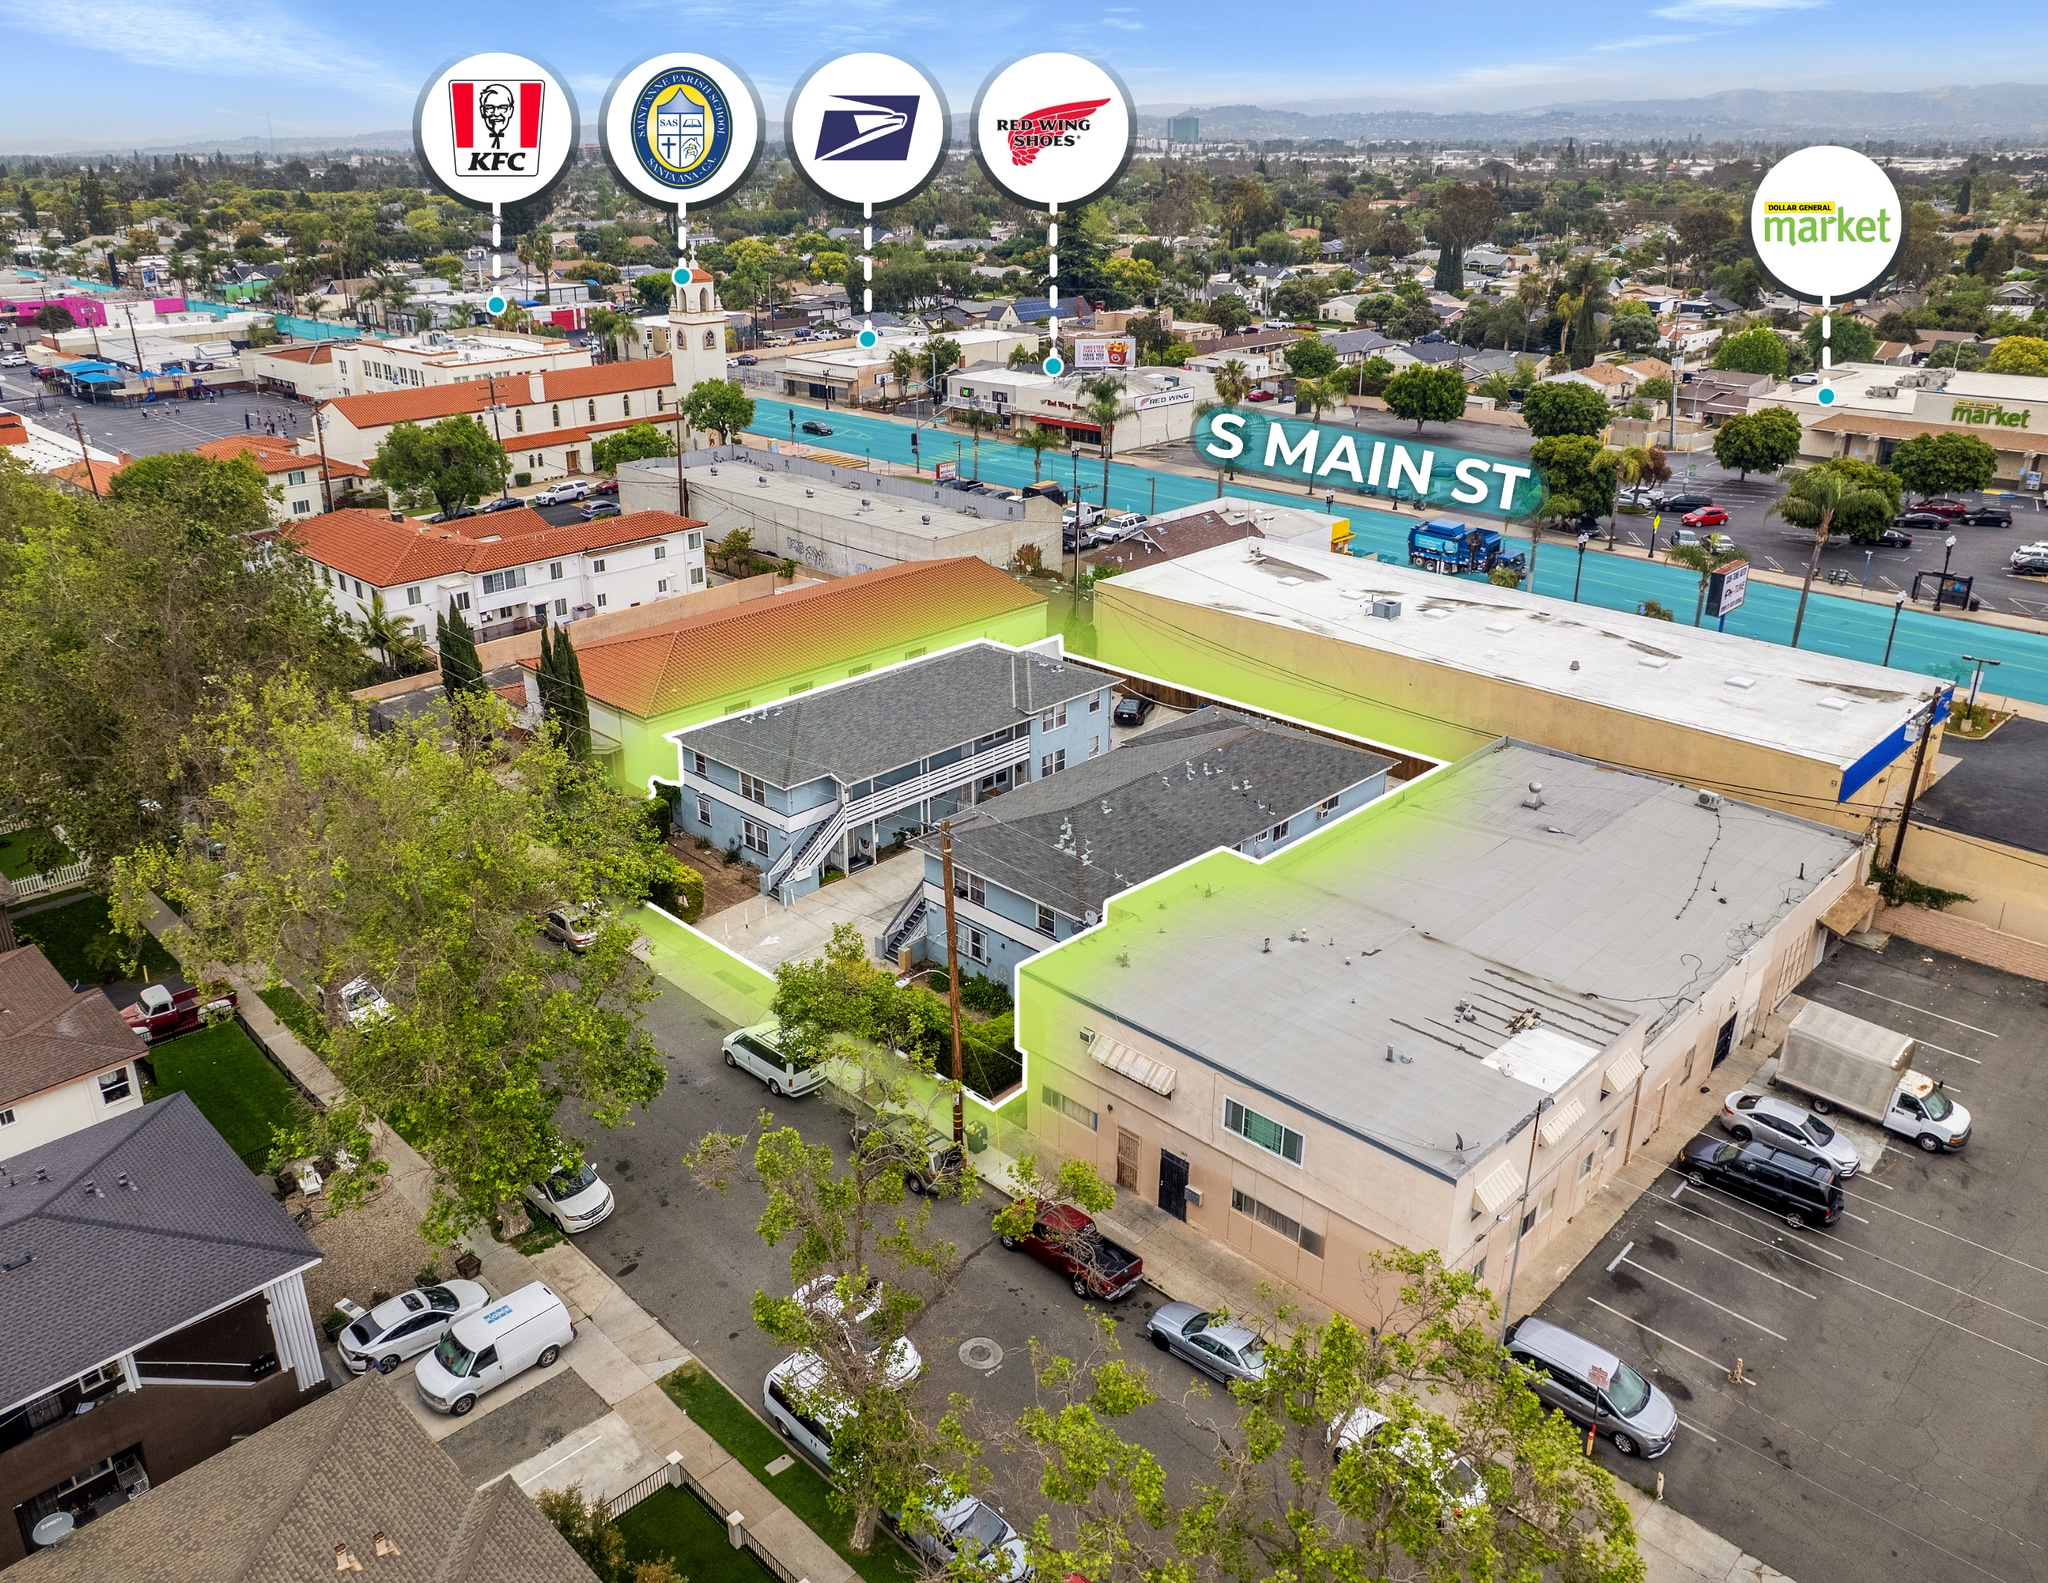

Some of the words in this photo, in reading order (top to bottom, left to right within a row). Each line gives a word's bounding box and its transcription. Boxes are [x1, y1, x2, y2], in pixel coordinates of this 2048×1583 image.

[1149, 397, 1167, 405] RED
[1168, 392, 1190, 401] WING
[1047, 399, 1057, 407] Red
[1058, 401, 1071, 411] Wing
[1951, 405, 2031, 429] market
[45, 1516, 63, 1528] DIRECTV
